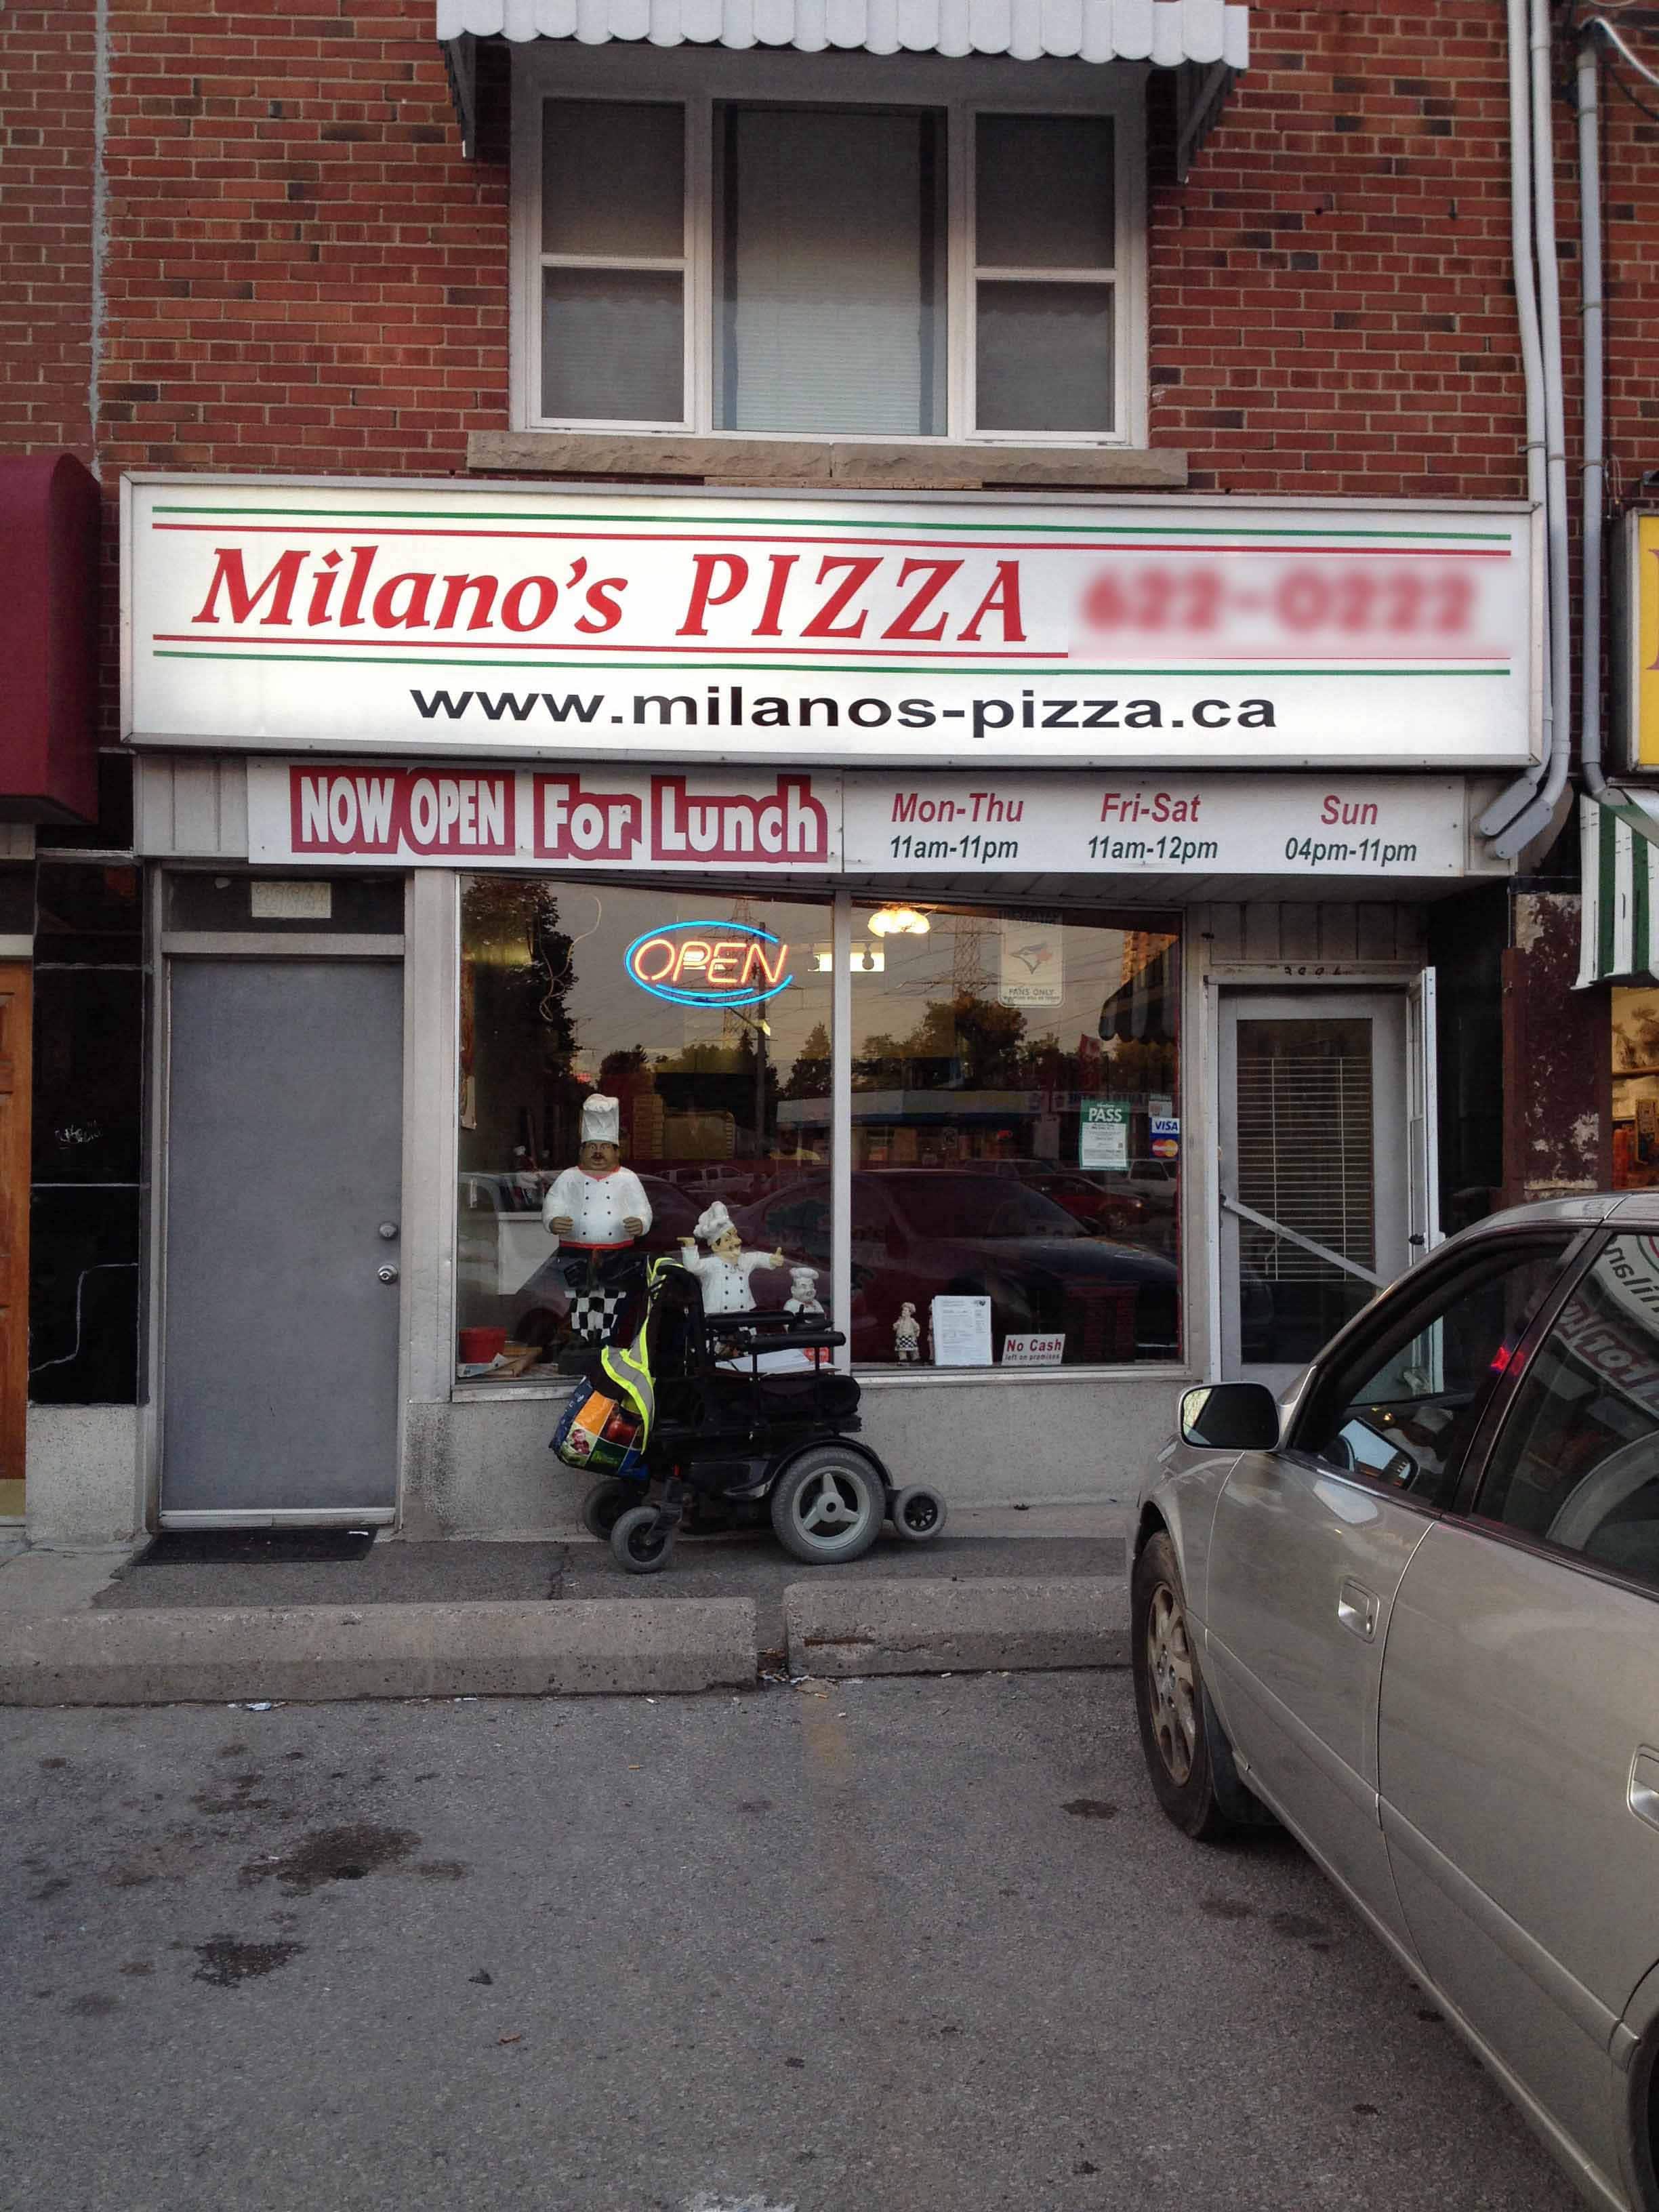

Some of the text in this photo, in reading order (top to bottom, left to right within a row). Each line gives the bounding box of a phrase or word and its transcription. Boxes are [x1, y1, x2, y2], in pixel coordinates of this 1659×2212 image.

[192, 545, 629, 634] Milano's
[676, 553, 1028, 642] PIZZA
[410, 686, 1276, 738] www.milanos-pizza.ca
[300, 777, 818, 853] NOW OPEN For Lunch
[891, 793, 1378, 825] Mon-Thu Fri-Sat Sun
[890, 835, 1417, 865] 11am-11pm 11am-12pm 04pm-11pm
[634, 938, 788, 985] OPEN
[1088, 1107, 1122, 1122] PASS
[1155, 1120, 1179, 1131] VISA
[1004, 1353, 1017, 1361] left
[1006, 1338, 1062, 1352] No Cash
